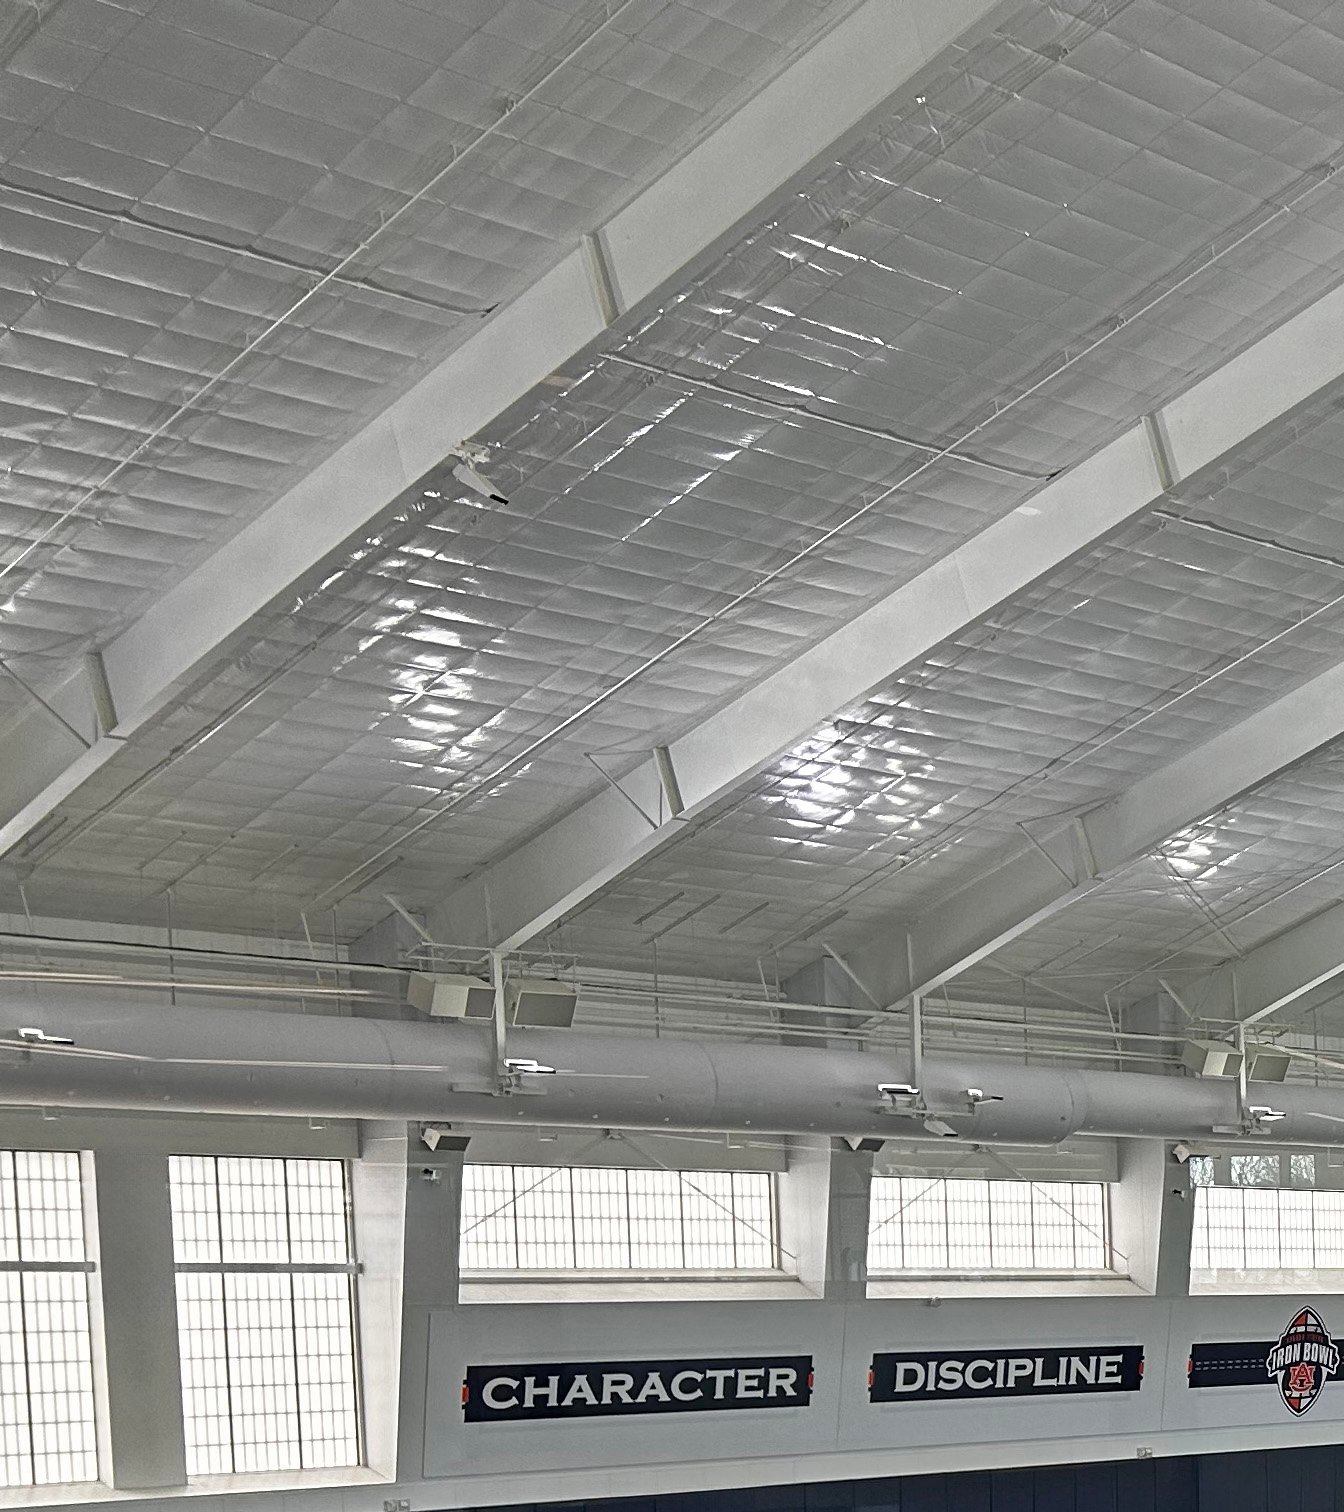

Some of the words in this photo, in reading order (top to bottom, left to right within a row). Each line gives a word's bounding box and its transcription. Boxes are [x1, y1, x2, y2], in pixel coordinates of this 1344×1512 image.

[893, 1353, 1124, 1393] DISCIPLINE
[1271, 1342, 1302, 1371] IRON
[1303, 1342, 1335, 1370] BOWL
[481, 1366, 799, 1411] CHARACTER
